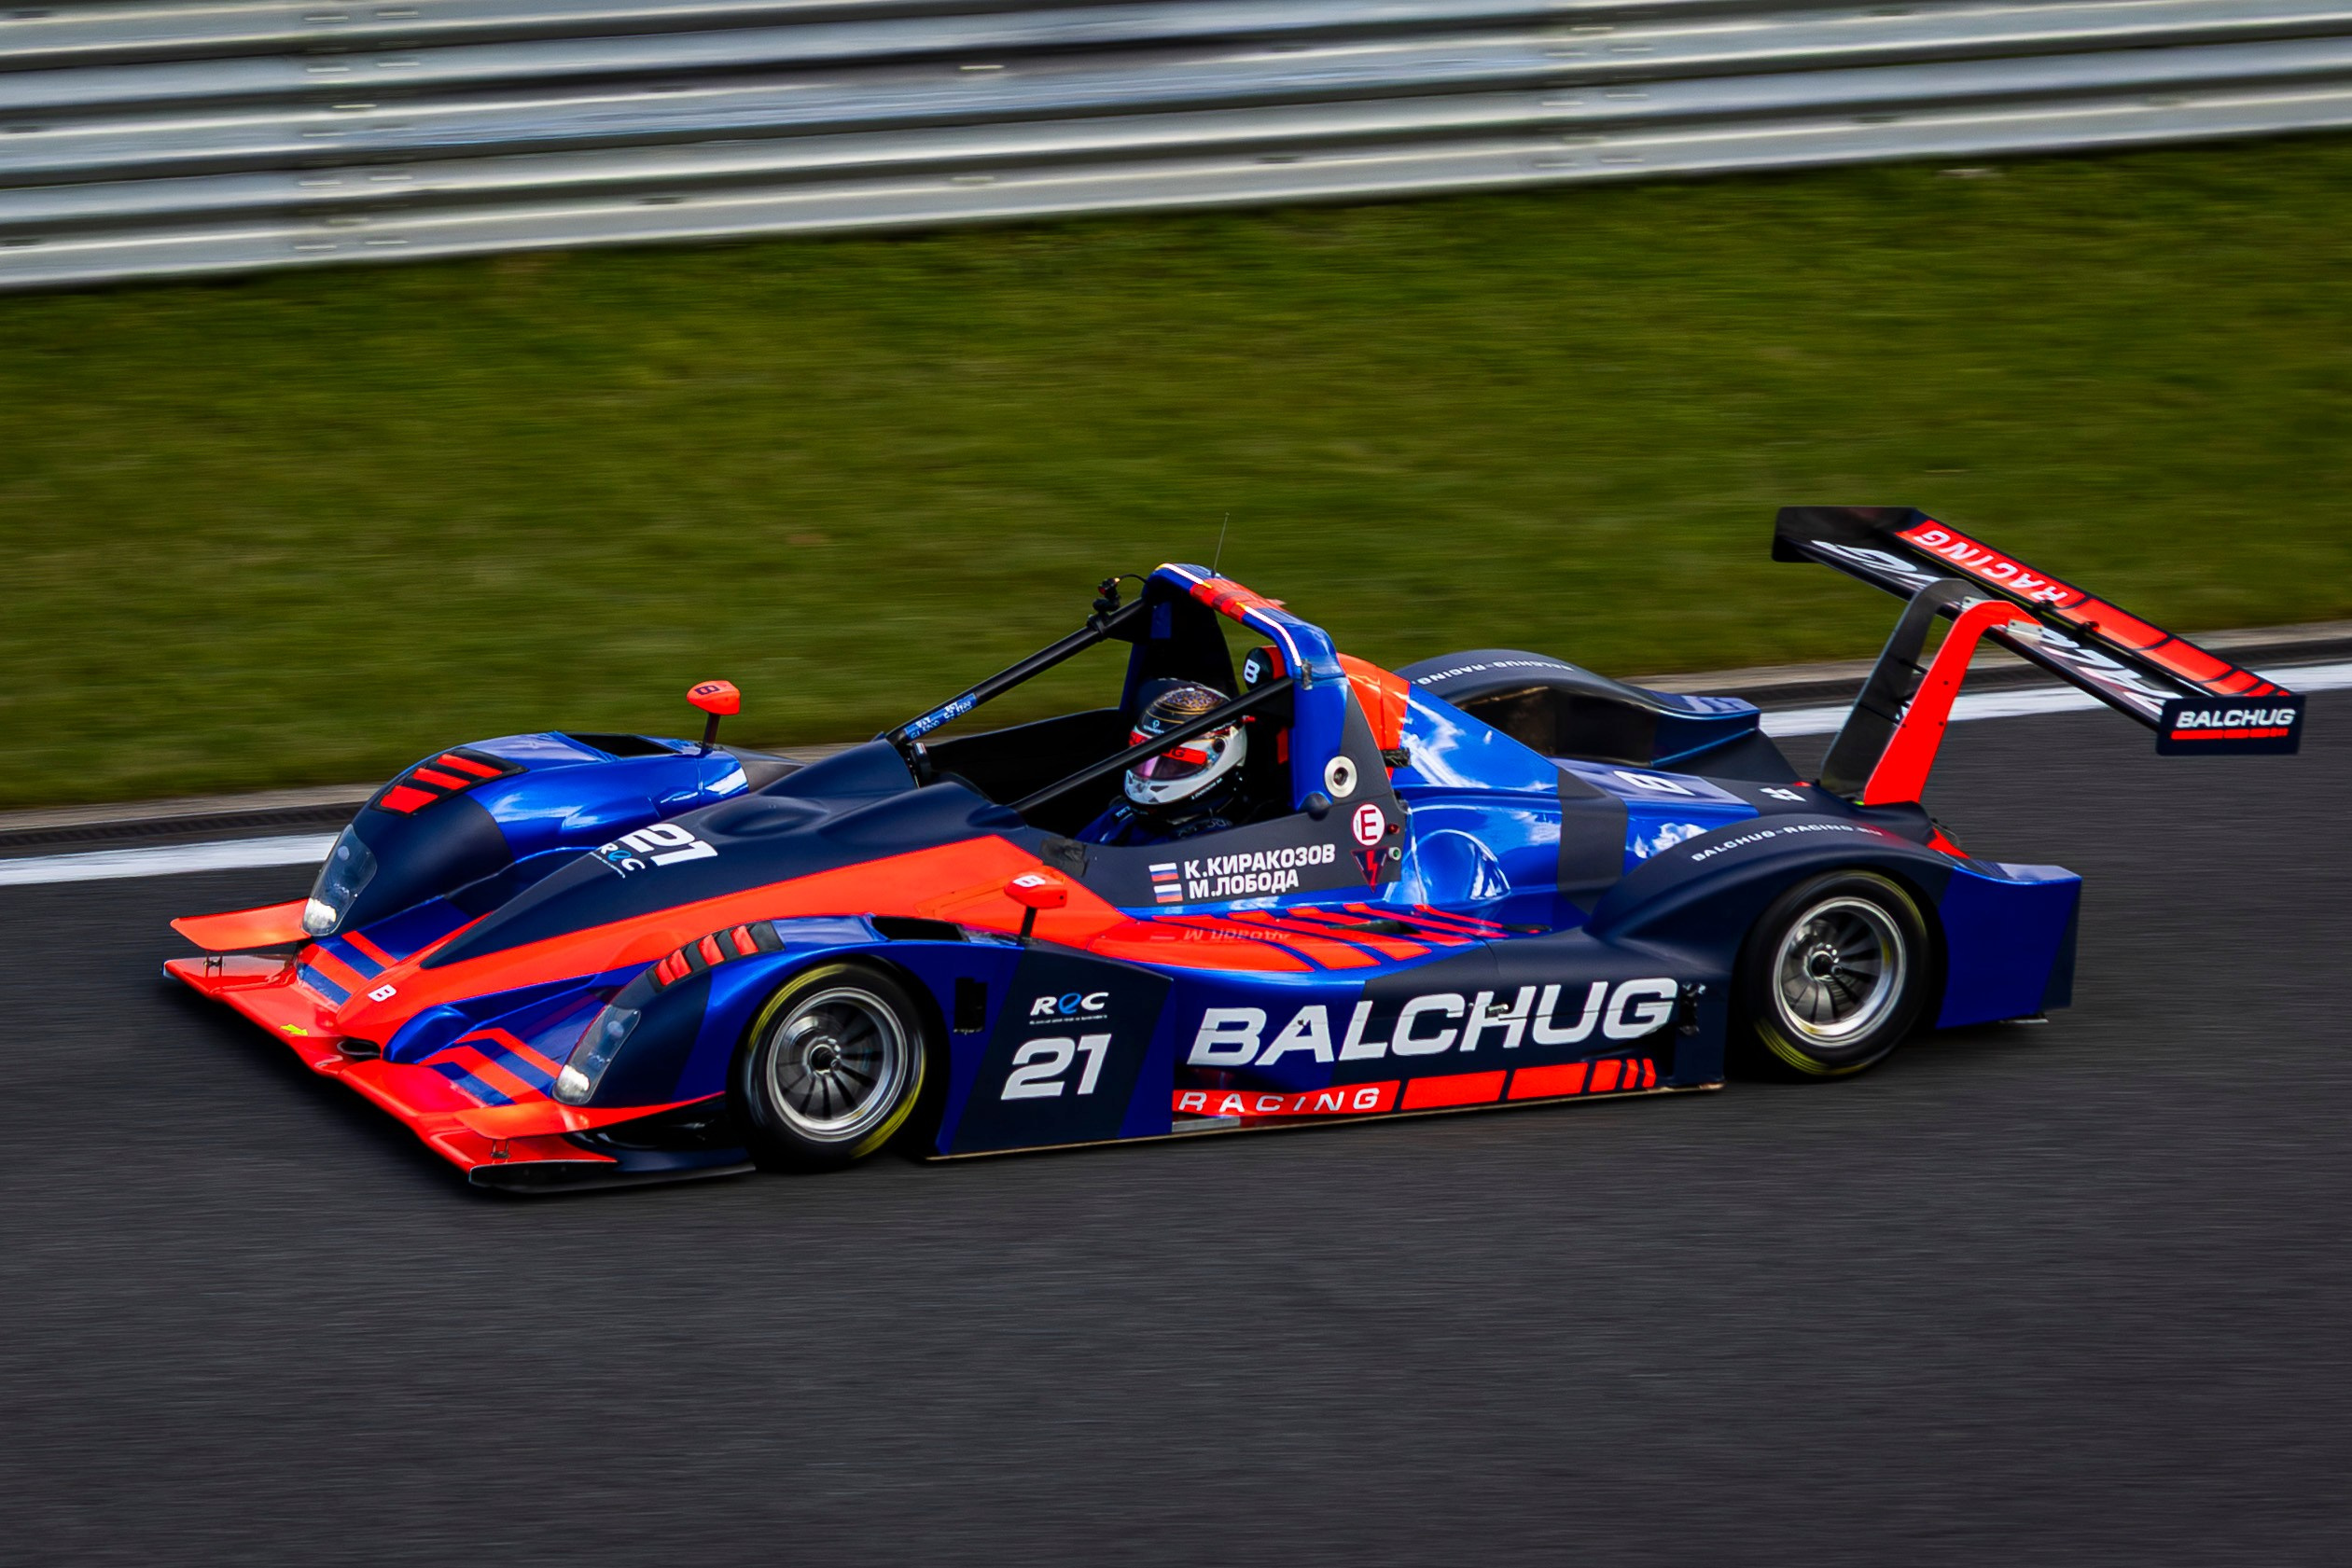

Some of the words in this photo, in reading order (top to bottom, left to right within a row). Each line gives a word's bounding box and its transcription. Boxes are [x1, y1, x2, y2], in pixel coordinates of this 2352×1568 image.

[1913, 530, 2068, 603] RACING
[1244, 659, 1260, 684] B
[2176, 708, 2297, 728] BALCHUG
[1360, 809, 1378, 841] E
[618, 823, 718, 867] 21
[1184, 843, 1336, 880] К.КИРАКОЗОВ
[1189, 868, 1300, 899] М.ЛОБОДА
[368, 984, 397, 1003] B
[1187, 978, 1678, 1066] BALCHUG
[1000, 1033, 1112, 1100] 21
[1178, 1088, 1380, 1113] RACING
